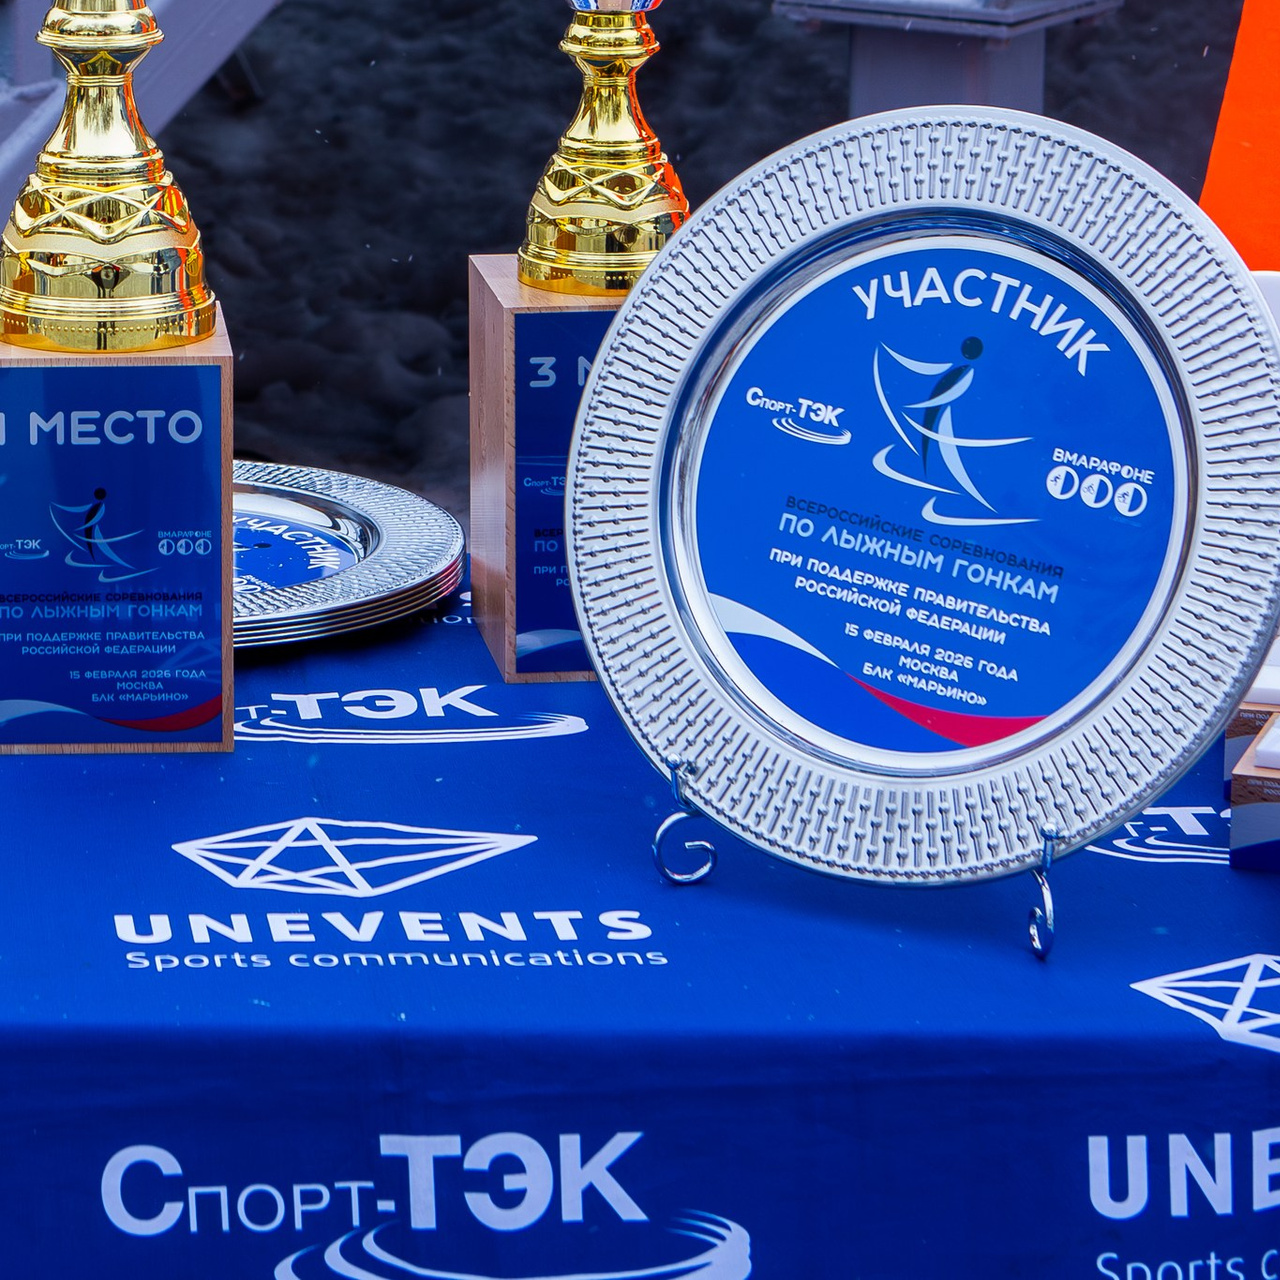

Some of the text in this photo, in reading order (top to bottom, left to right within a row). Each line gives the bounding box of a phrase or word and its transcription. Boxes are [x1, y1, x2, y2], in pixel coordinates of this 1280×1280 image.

[851, 266, 1111, 377] УЧАСТНИК
[529, 356, 557, 387] 3
[29, 409, 203, 446] МЕСТО
[1051, 447, 1156, 485] ВМАРАФОНЕ
[523, 476, 566, 488] Спорт-ТЭ
[534, 540, 558, 552] ПО
[784, 494, 1065, 580] ВСЕРОССИЙСКИЕ СОРЕВНОВАНИЯ
[533, 565, 557, 575] ПРИ
[778, 512, 1060, 604] ПО ЛЫЖНЫМ ГОНКАМ
[105, 590, 203, 603] СОРЕВНОВАНИЯ
[768, 547, 1051, 636] ПРИ ПОДДЕРЖКЕ ПРАВИТЕЛЬСТВА
[31, 605, 120, 619] ЛЫЖНЫМ
[128, 604, 203, 618] ГОНКАМ
[795, 575, 1007, 646] РОССИЙСКОЙ ФЕДЕРАЦИИ
[21, 643, 177, 656] РОССИЙСКОЙ ФЕДЕРАЦИИ
[26, 632, 102, 643] ПОДДЕРЖКЕ
[106, 631, 206, 642] ПРАВИТЕЛЬСТВА
[843, 622, 1019, 682] 15 ФЕВРАЛЯ 2026 ГОДА
[69, 669, 207, 680] 15 ФЕВРАЛЯ 2026 ГОДА
[898, 655, 959, 683] МОСКВА
[116, 681, 164, 691] МОСКВА
[118, 692, 189, 702] «МАРЬИНО»
[861, 662, 987, 707] БЛК «МАРЬИНО»
[113, 910, 654, 944] UNEVENTS
[126, 948, 669, 972] Sports communications
[100, 1131, 649, 1237] Спорт-ТЭК
